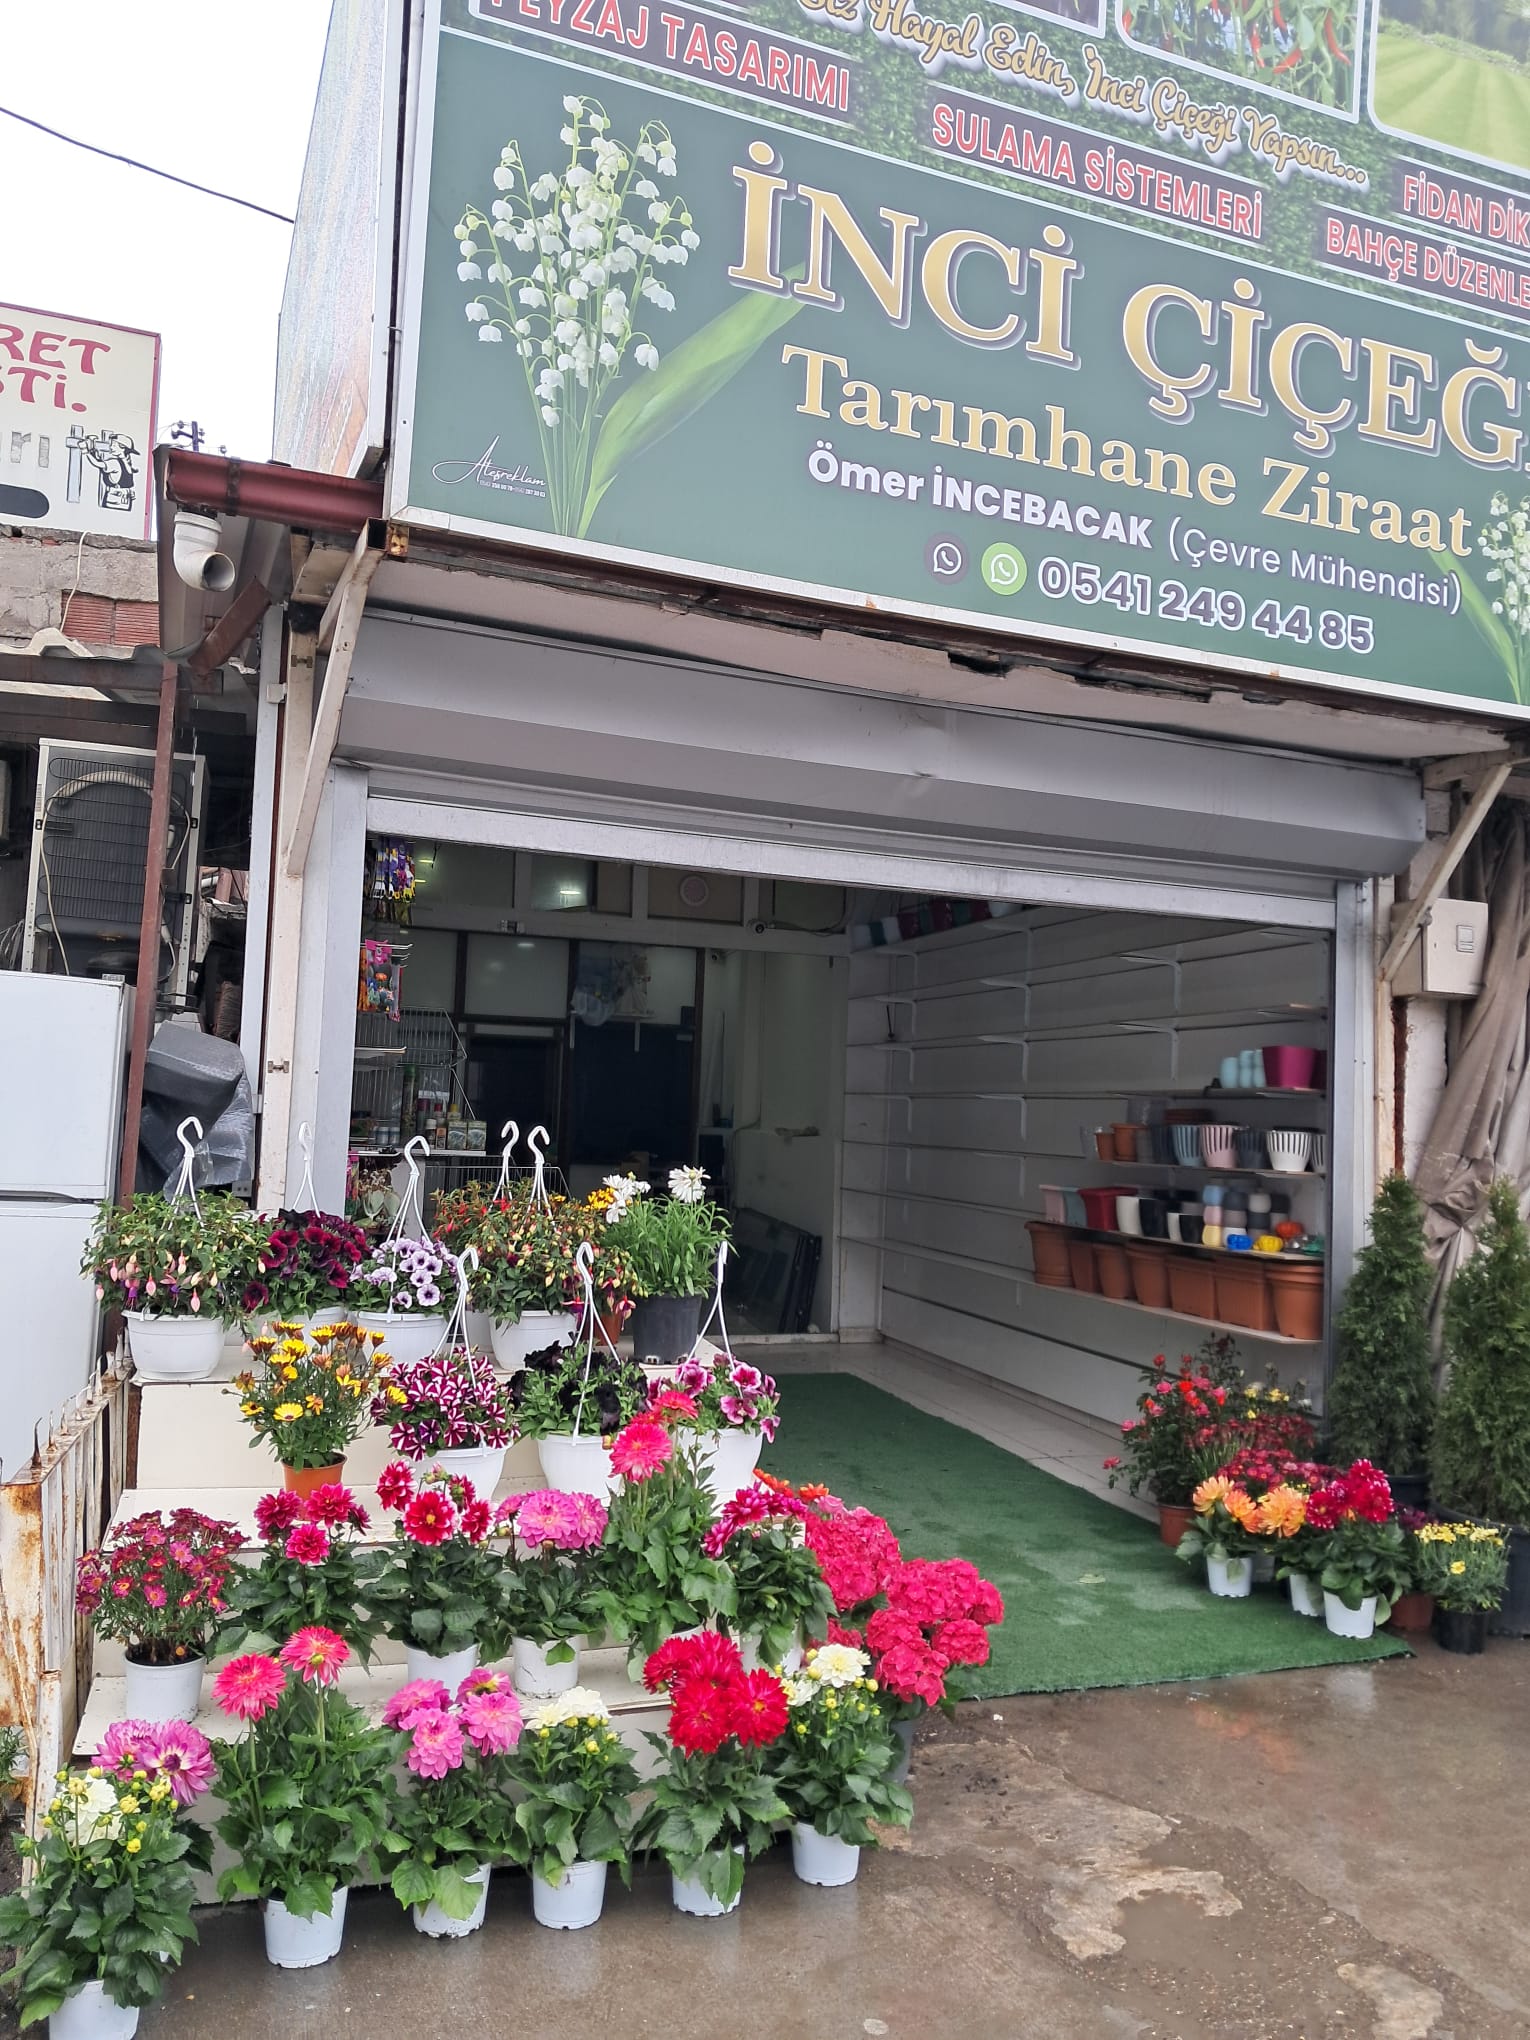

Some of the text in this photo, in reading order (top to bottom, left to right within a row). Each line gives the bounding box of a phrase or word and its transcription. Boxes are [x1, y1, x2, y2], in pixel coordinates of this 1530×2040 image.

[491, 0, 849, 112] YZAJ TASARIMI
[800, 0, 858, 20] iz
[869, 0, 979, 64] Hayal
[983, 24, 1076, 96] Edin,
[1082, 45, 1146, 113] İnci
[1151, 78, 1239, 153] Çiçeği
[932, 103, 1263, 239] SULAMA SİSTEMLERİ
[1403, 170, 1482, 233] FİDAN
[728, 140, 1530, 466] İNCİ ÇİÇEĞ
[1327, 217, 1530, 309] BAHÇE DÜZENLE
[782, 344, 1472, 556] Tarımhane Ziraat
[808, 440, 1461, 614] Ömer İNCEBACAK (Çevre Mühendisi)
[1038, 556, 1374, 654] 0541 249 44 85
